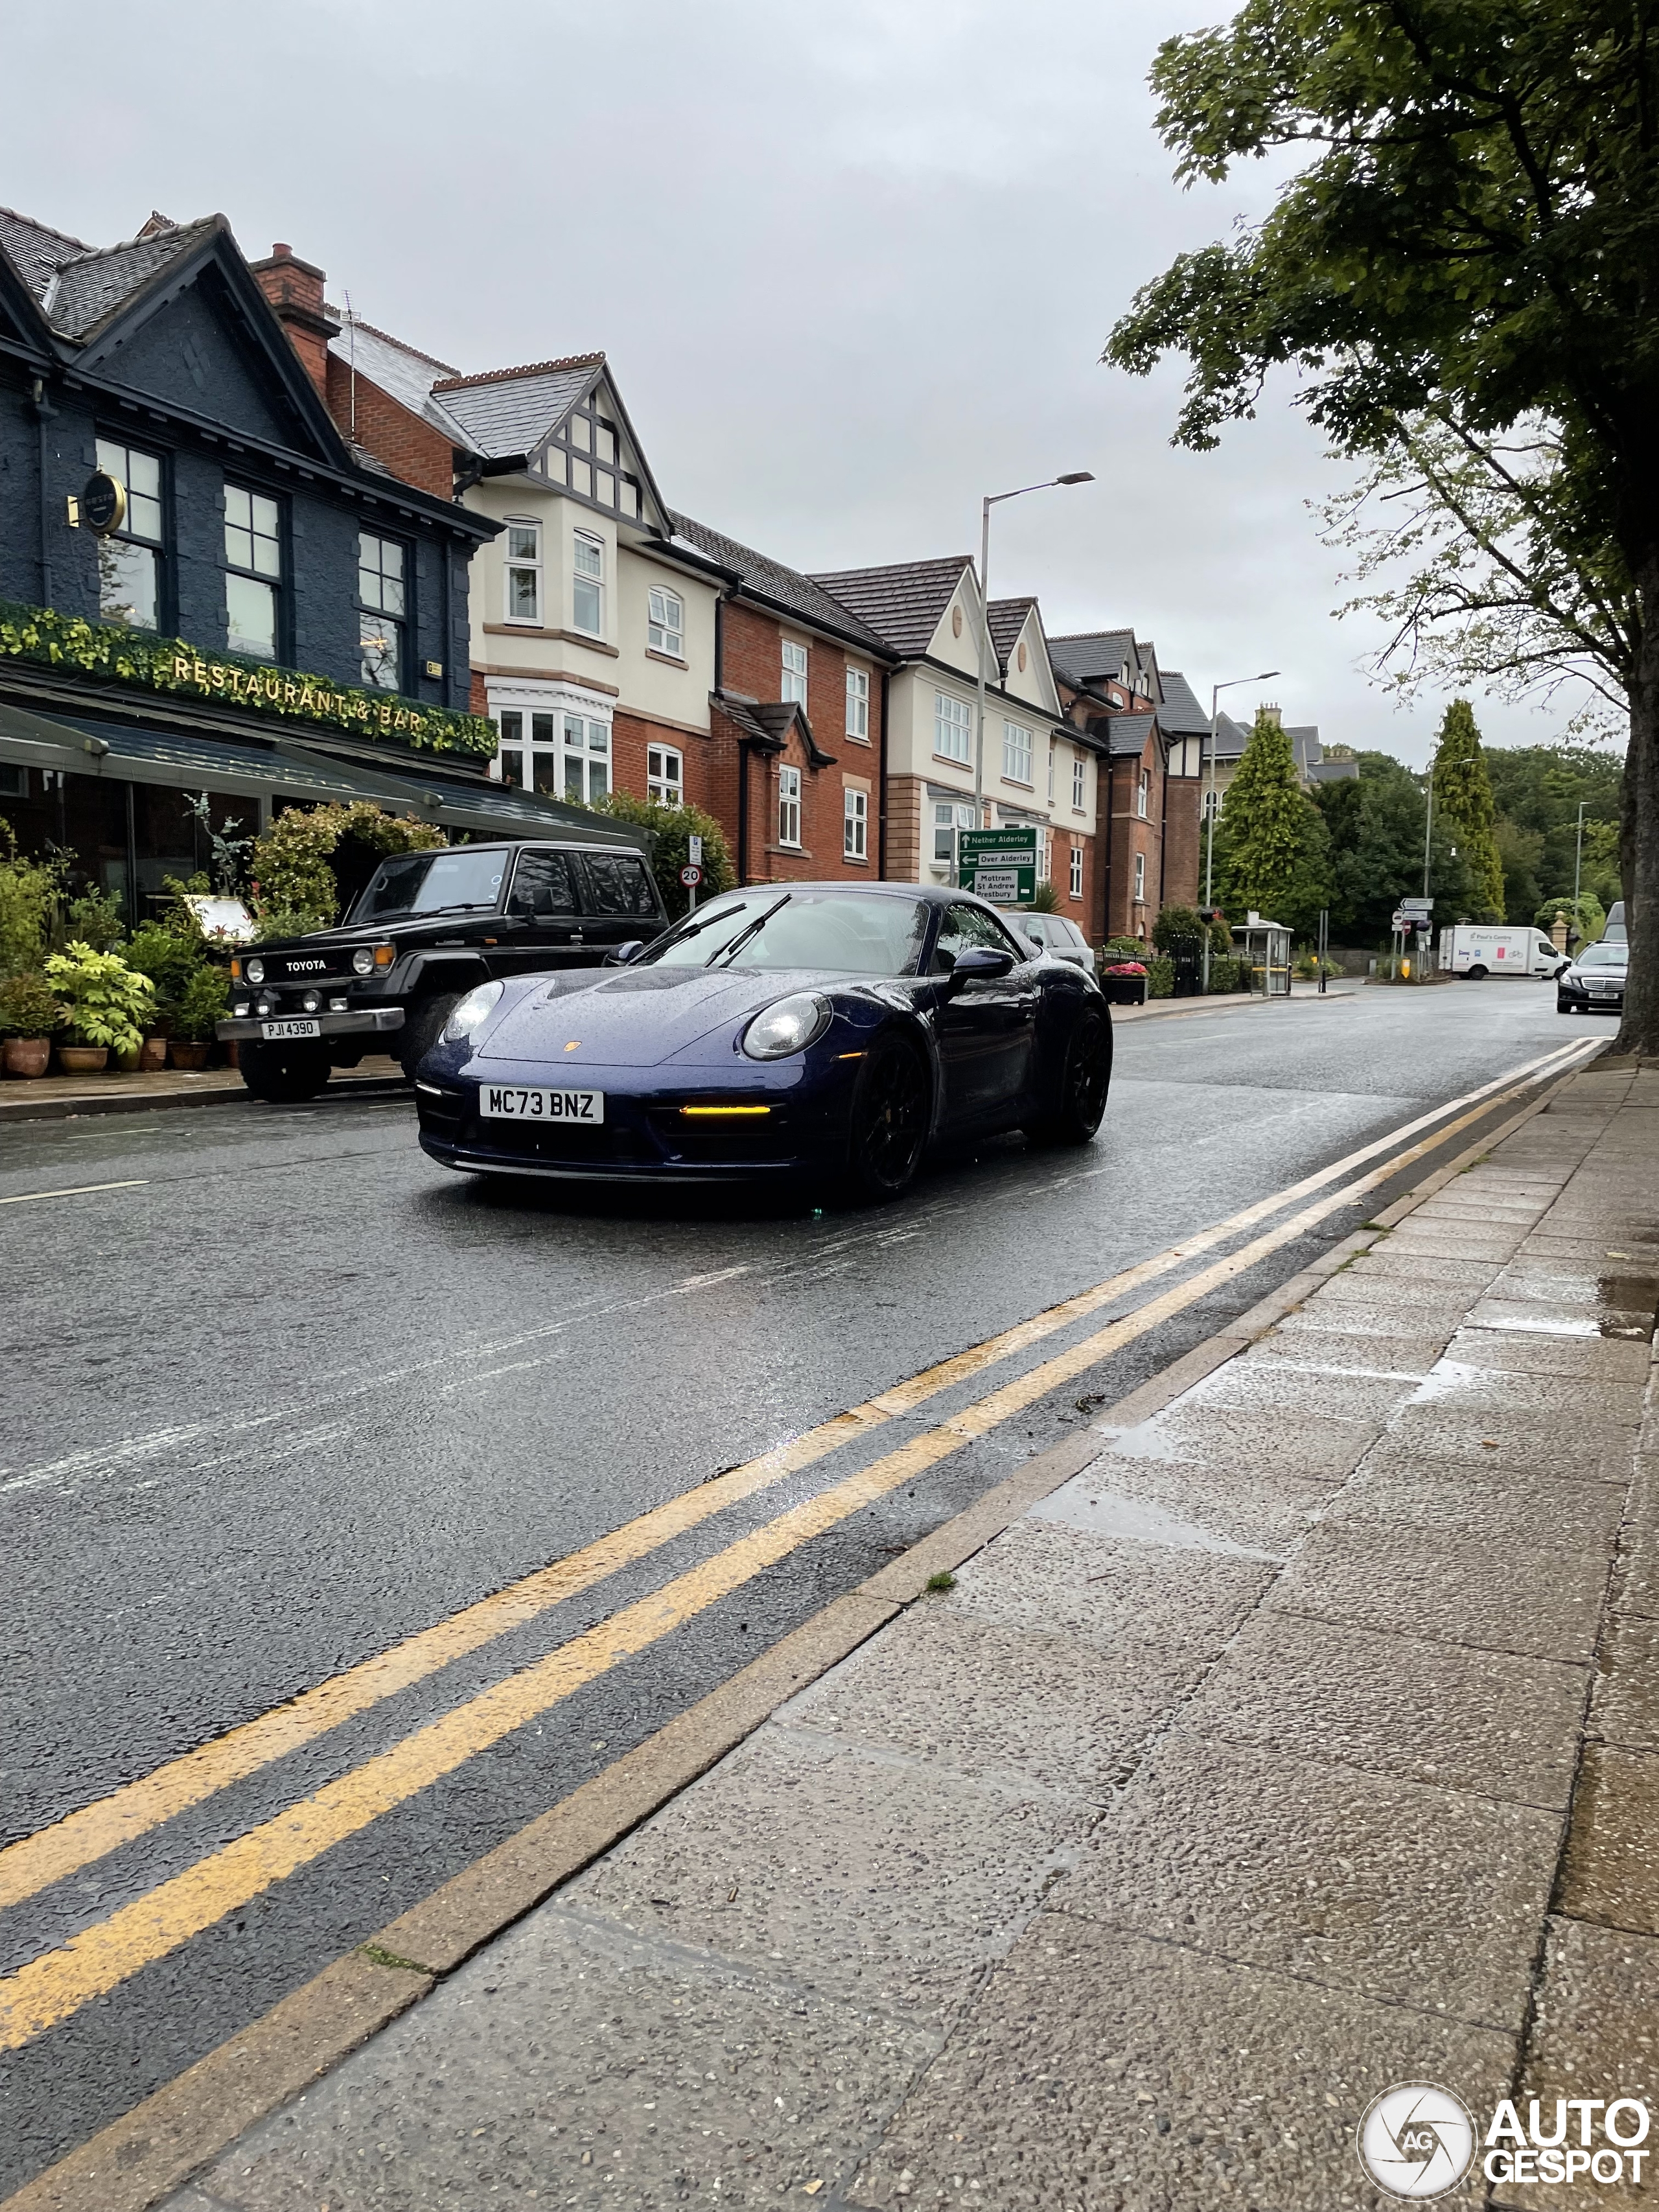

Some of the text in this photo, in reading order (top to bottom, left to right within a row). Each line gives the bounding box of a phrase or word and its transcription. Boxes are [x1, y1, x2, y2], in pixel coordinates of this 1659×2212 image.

[175, 657, 421, 731] RESTAURANT & BAR
[683, 870, 698, 881] 20
[286, 960, 327, 972] TOYOTA
[286, 1022, 314, 1035] 4390
[489, 1089, 594, 1118] MC73 BNZ
